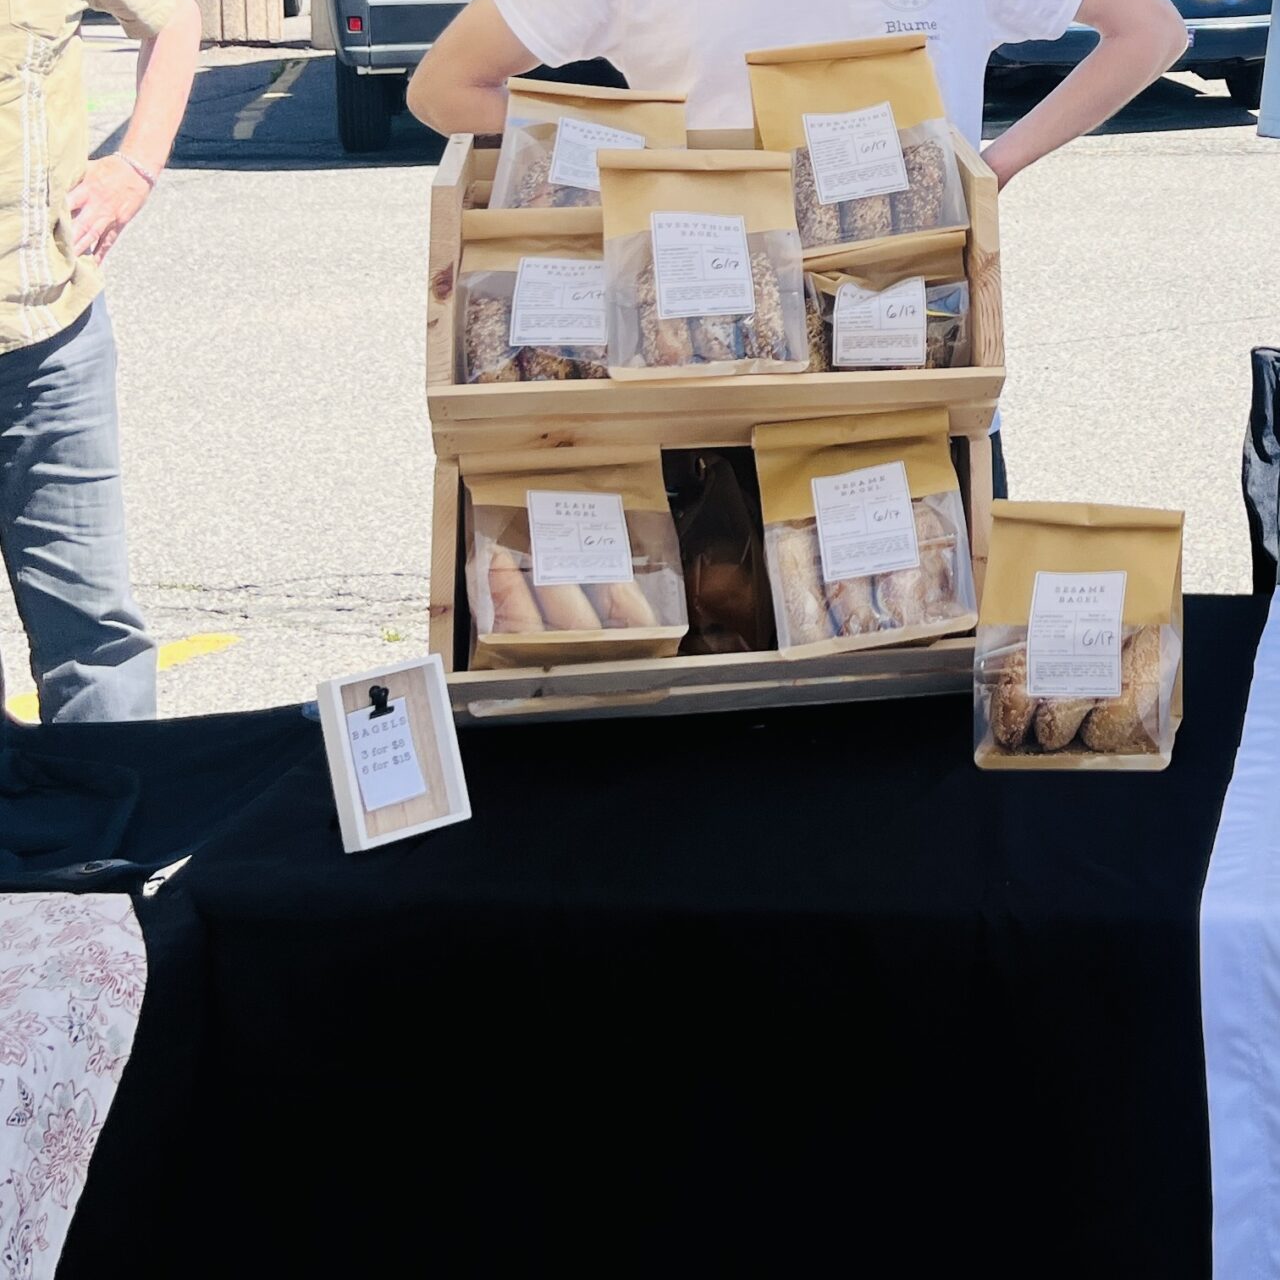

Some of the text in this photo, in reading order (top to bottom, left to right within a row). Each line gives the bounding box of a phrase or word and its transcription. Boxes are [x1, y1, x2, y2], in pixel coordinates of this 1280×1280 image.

[885, 19, 938, 34] Blume
[657, 221, 741, 233] EVERYTHING
[680, 230, 721, 238] BAGEL
[710, 257, 740, 270] 6/17
[886, 303, 917, 319] 6/17
[555, 502, 597, 511] PLAIN
[555, 509, 598, 518] BAGEL
[872, 508, 900, 522] 6/17
[1054, 585, 1106, 594] SESAME
[1058, 595, 1100, 604] BAGEL
[1081, 628, 1115, 647] 6/17
[352, 715, 408, 741] BAGELS
[361, 749, 369, 760] 3
[372, 745, 389, 757] for
[372, 761, 389, 772] for
